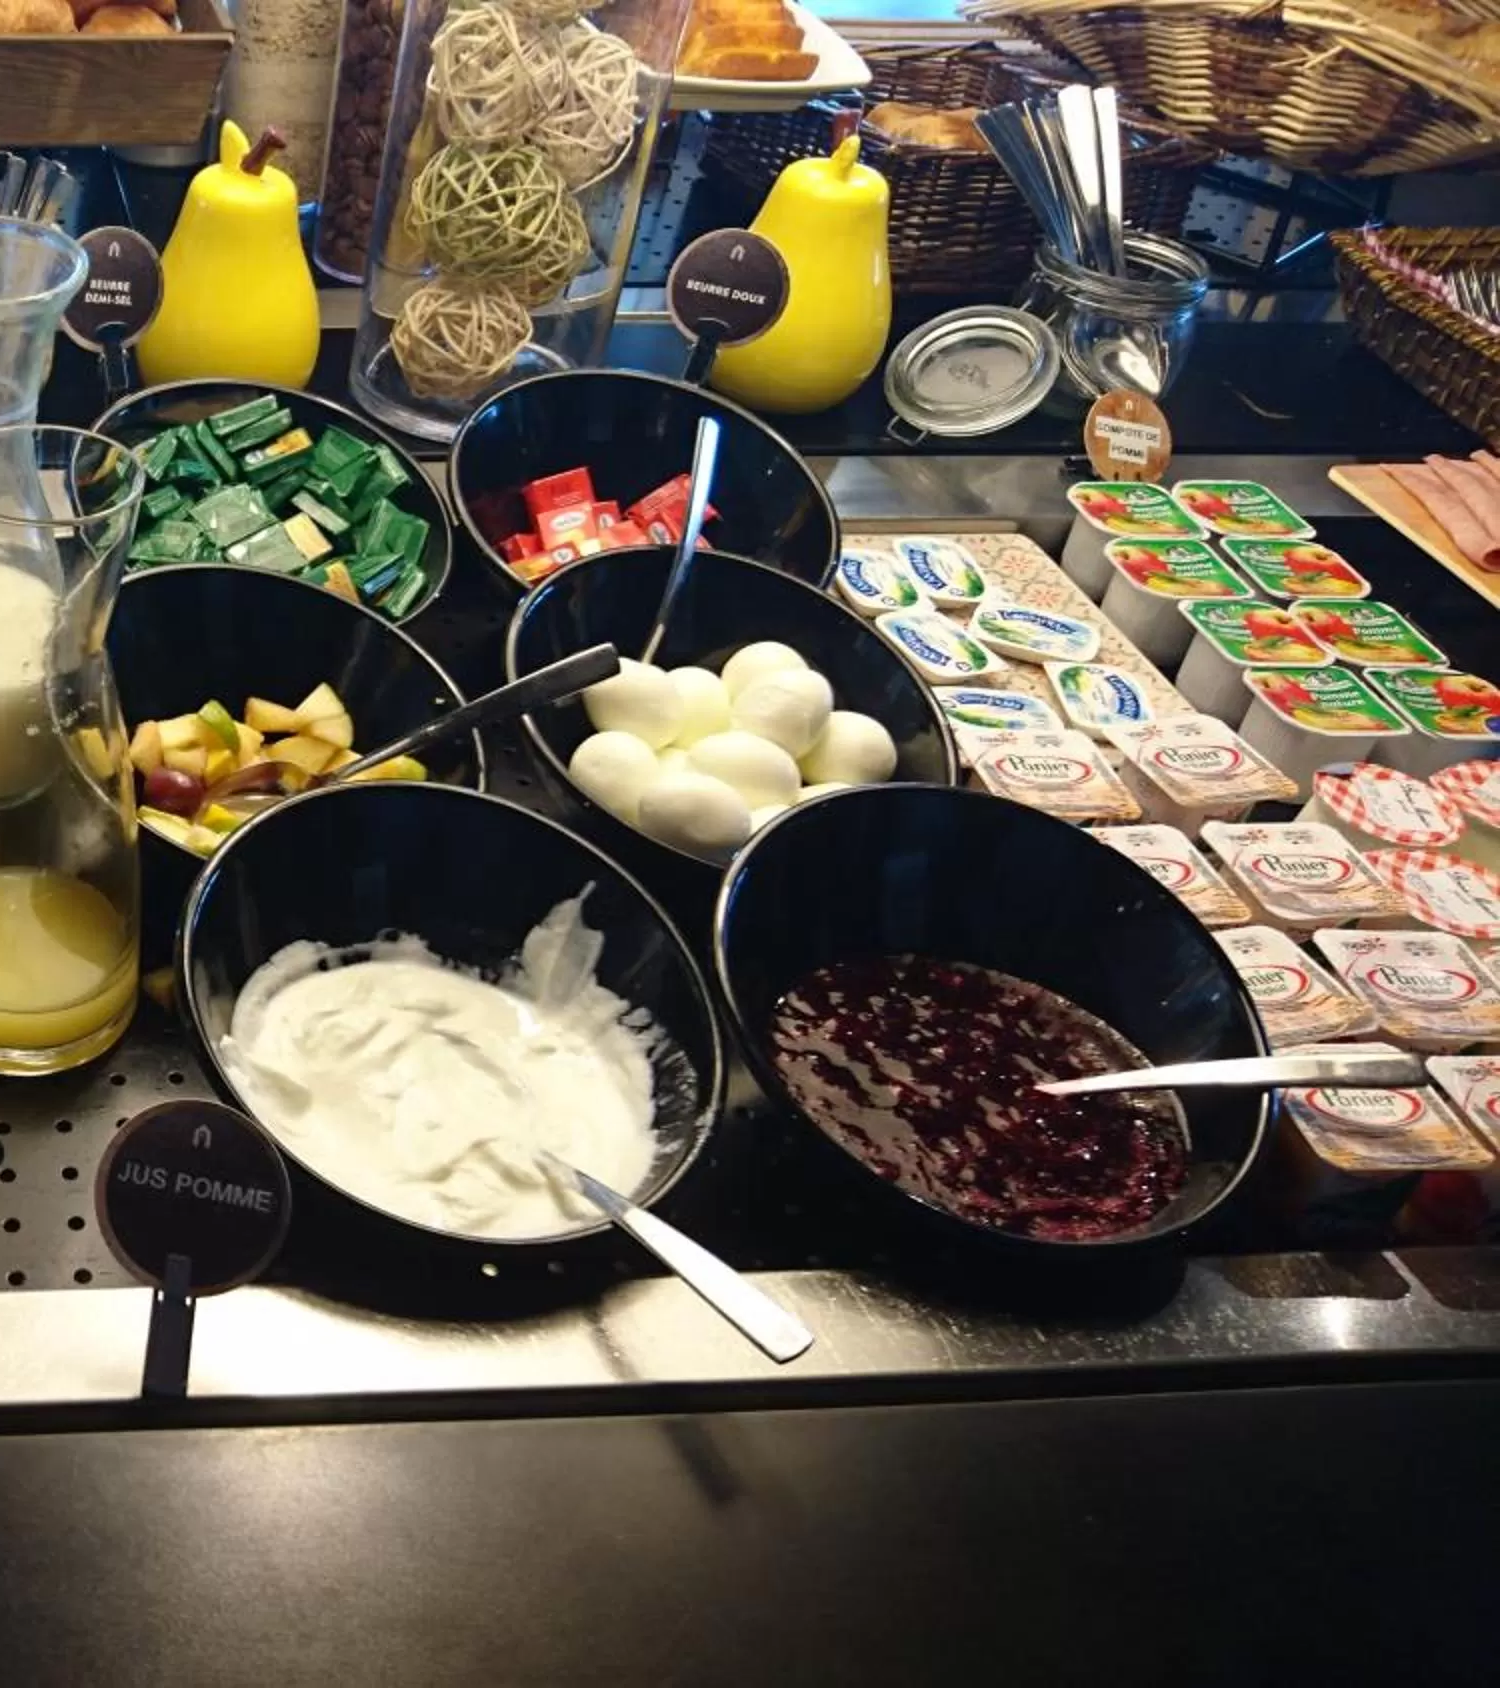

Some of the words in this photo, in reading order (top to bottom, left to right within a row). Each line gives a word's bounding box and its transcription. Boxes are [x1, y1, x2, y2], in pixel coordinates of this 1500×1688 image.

[89, 279, 131, 292] BEURRE
[685, 279, 731, 297] BEURRE
[731, 289, 767, 304] DOUX
[84, 292, 133, 306] DEMI-SEL
[1097, 421, 1145, 439] COMPOTE
[1146, 430, 1158, 443] DE
[1111, 444, 1145, 458] POMME
[1257, 853, 1328, 872] Panier
[117, 1160, 169, 1190] JUS
[174, 1172, 275, 1214] POMME
